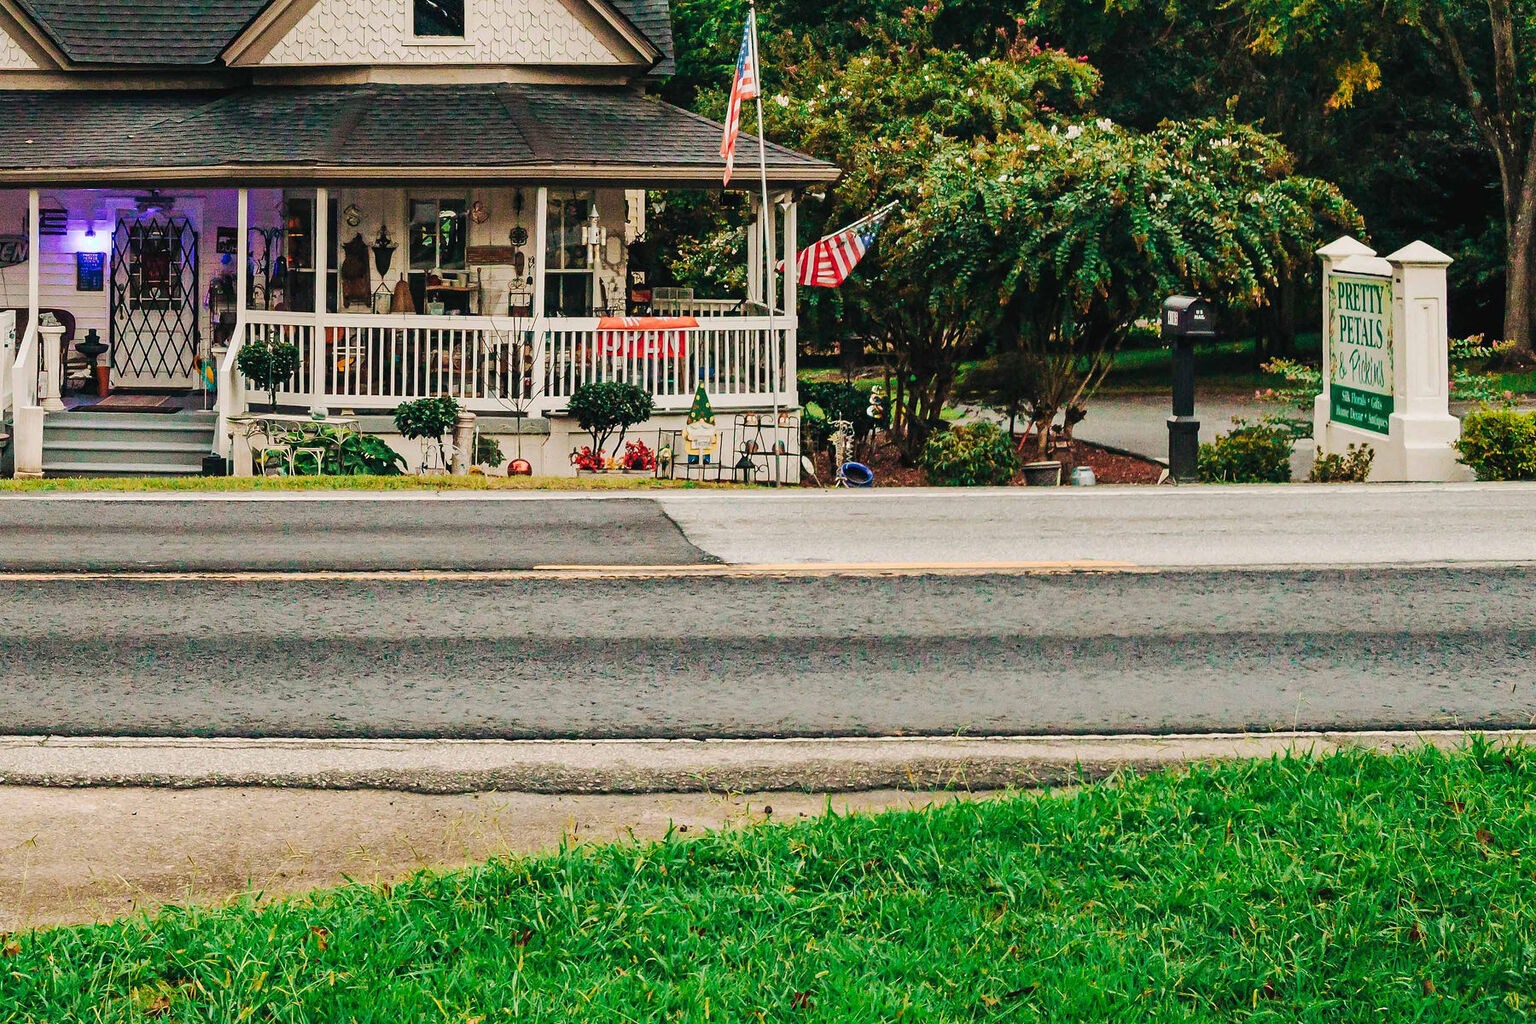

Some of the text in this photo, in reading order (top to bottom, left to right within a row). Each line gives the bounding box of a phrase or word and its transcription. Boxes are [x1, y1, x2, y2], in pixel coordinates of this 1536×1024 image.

[1338, 281, 1384, 314] PRETTY
[1339, 315, 1383, 349] PETALS
[1338, 349, 1384, 387] & Pickins
